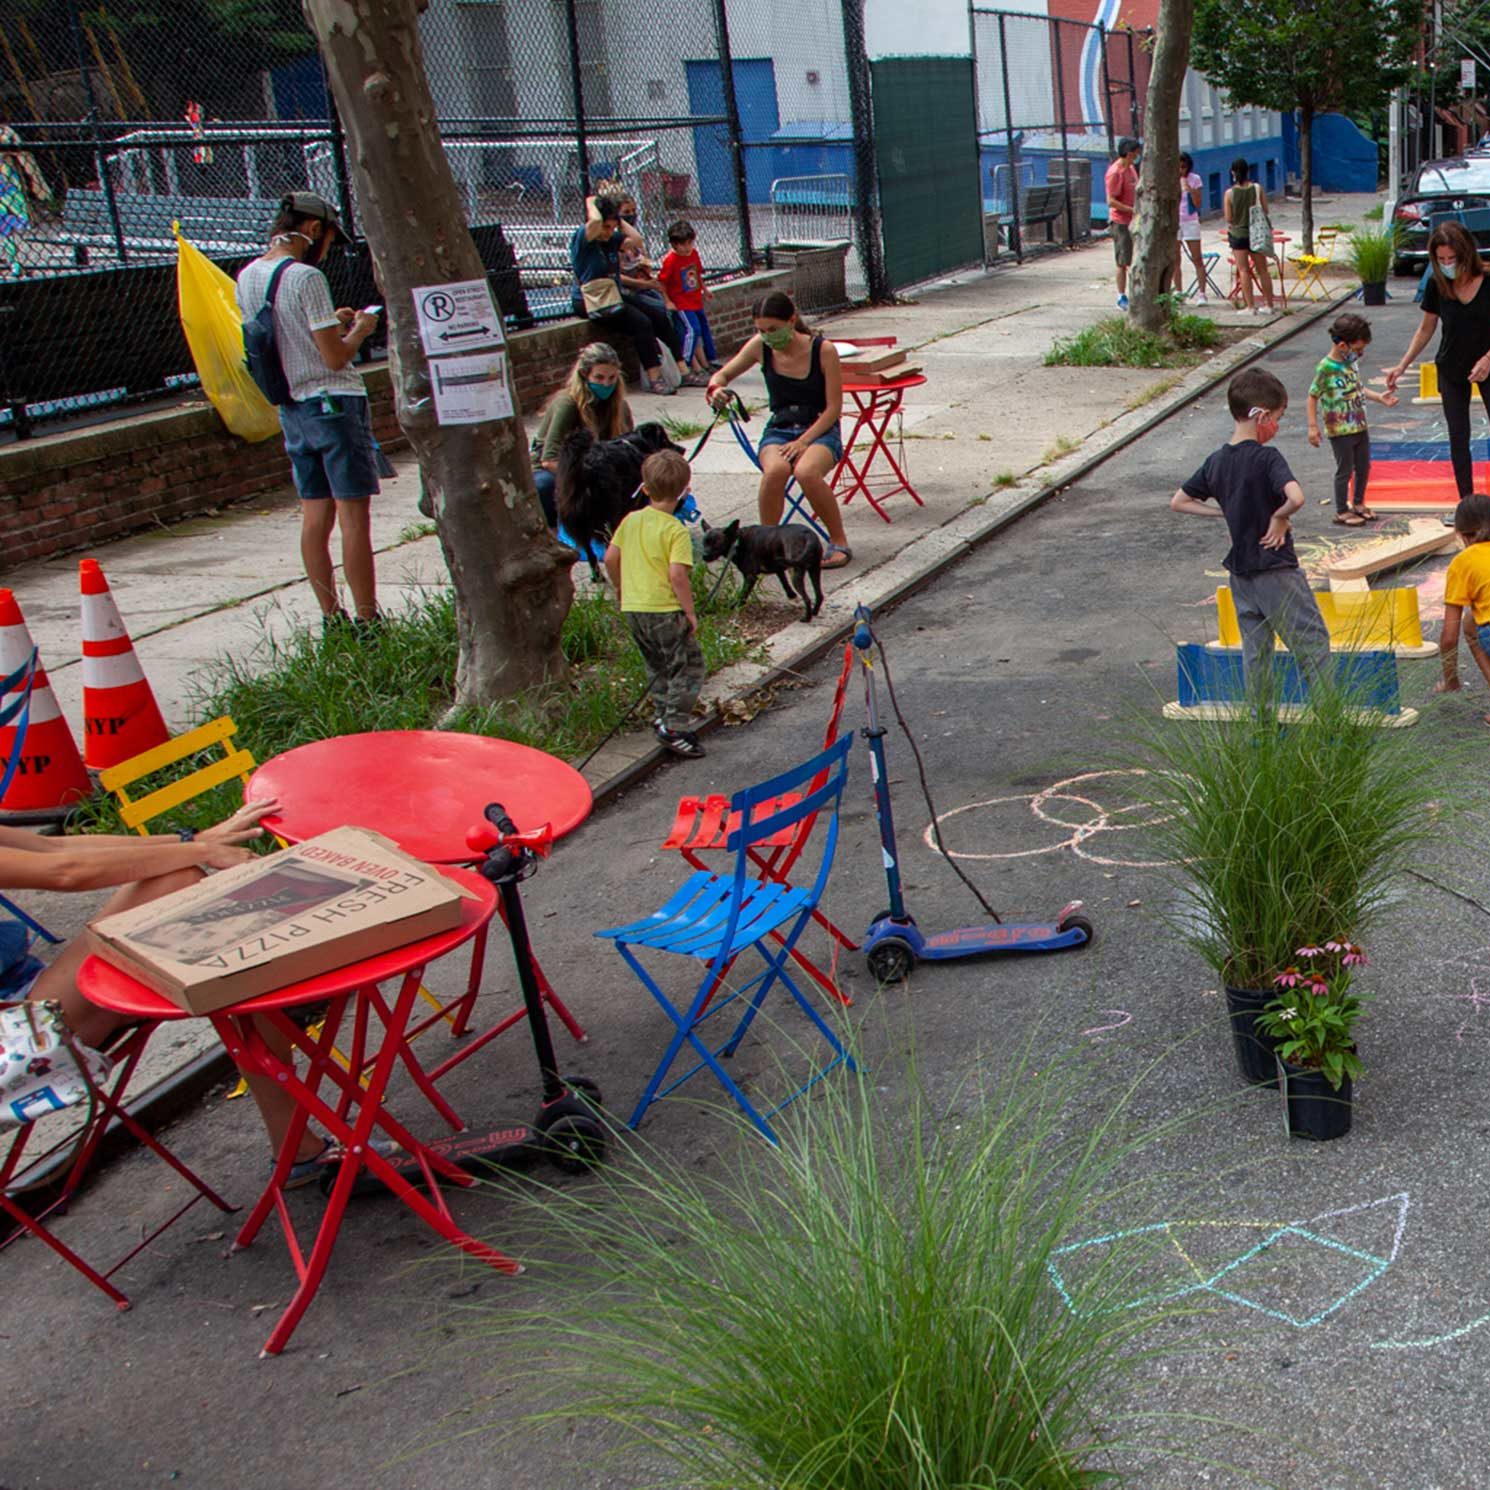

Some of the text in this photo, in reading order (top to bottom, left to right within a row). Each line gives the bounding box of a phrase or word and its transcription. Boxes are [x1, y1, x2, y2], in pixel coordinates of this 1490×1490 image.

[300, 846, 358, 867] BAKED
[350, 860, 400, 880] OVEN
[197, 872, 425, 968] FRESH PIZZA
